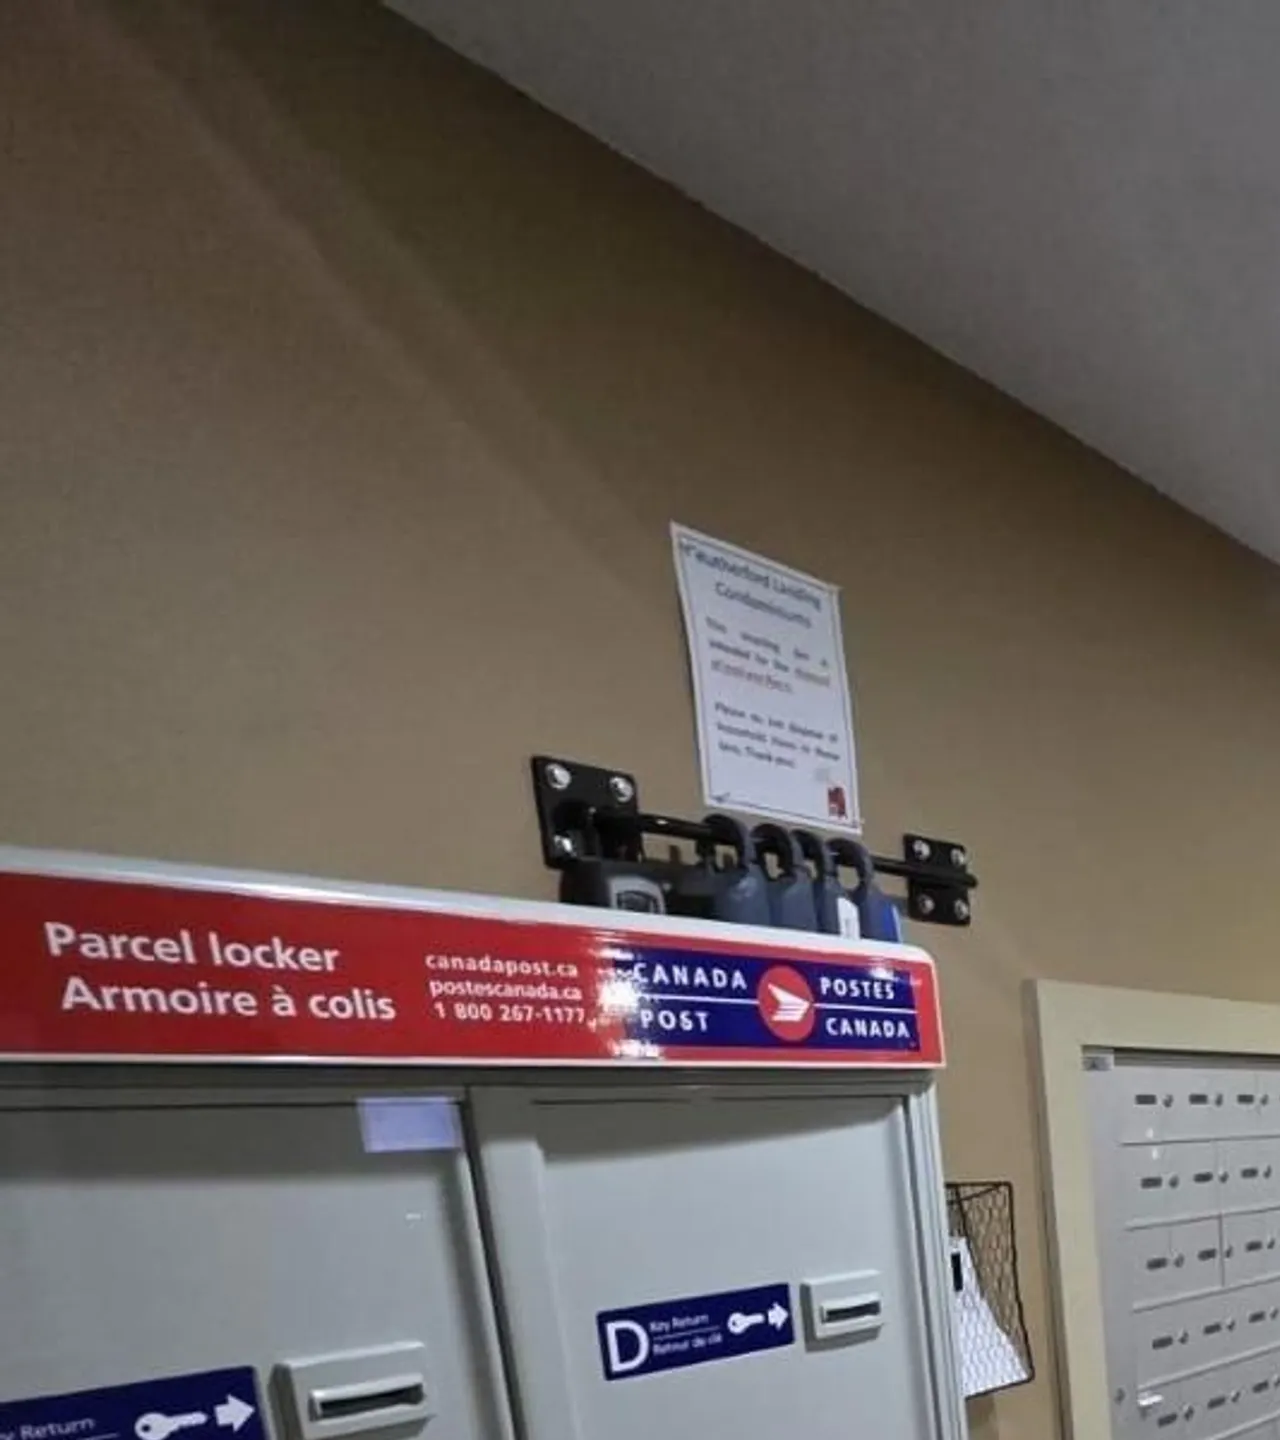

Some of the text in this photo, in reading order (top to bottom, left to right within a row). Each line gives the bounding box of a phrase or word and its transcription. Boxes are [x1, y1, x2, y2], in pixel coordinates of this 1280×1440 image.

[45, 922, 340, 971] Parcel locker
[425, 954, 578, 977] canadapost.ca
[633, 963, 747, 990] CANADA
[61, 976, 397, 1020] Armoire à colis
[429, 980, 582, 1001] postescanada.ca
[820, 976, 894, 1000] POSTES
[434, 1002, 585, 1024] 1 800 267-1177
[640, 1010, 710, 1032] POST
[825, 1017, 910, 1039] CANADA
[606, 1319, 649, 1372] D
[20, 1417, 96, 1440] Return
